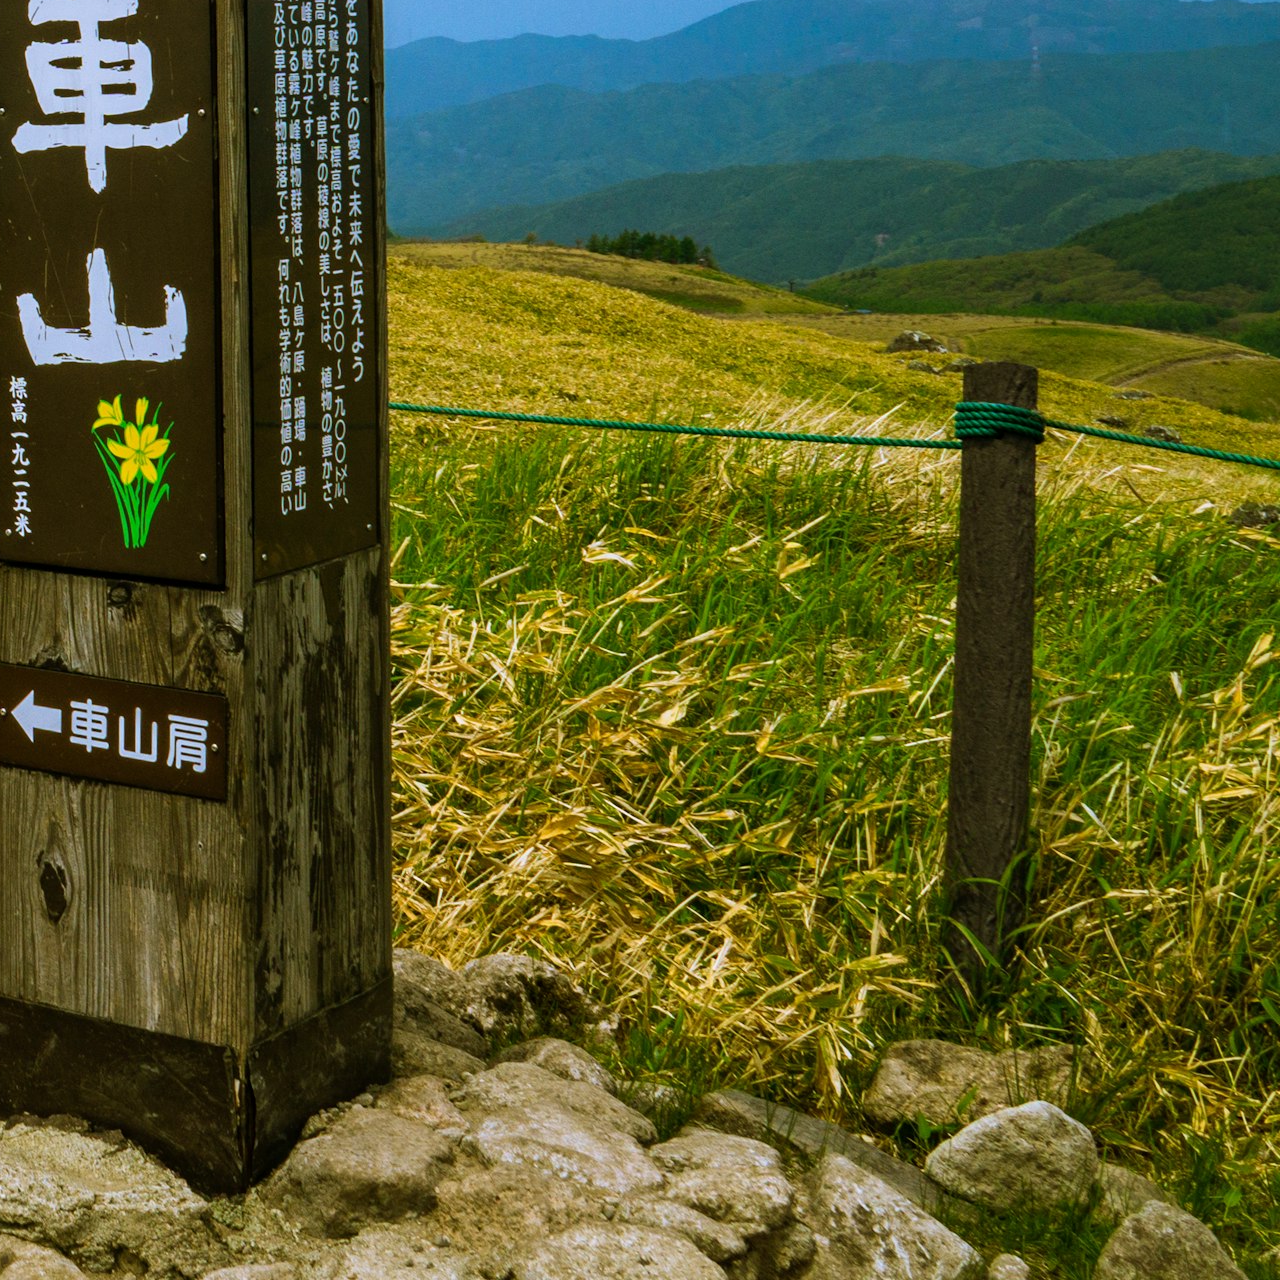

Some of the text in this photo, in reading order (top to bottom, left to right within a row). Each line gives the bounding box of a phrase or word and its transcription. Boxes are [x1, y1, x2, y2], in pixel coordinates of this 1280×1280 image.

[9, 375, 32, 538] 標高一九二五米
[69, 697, 209, 773] 車山肩
